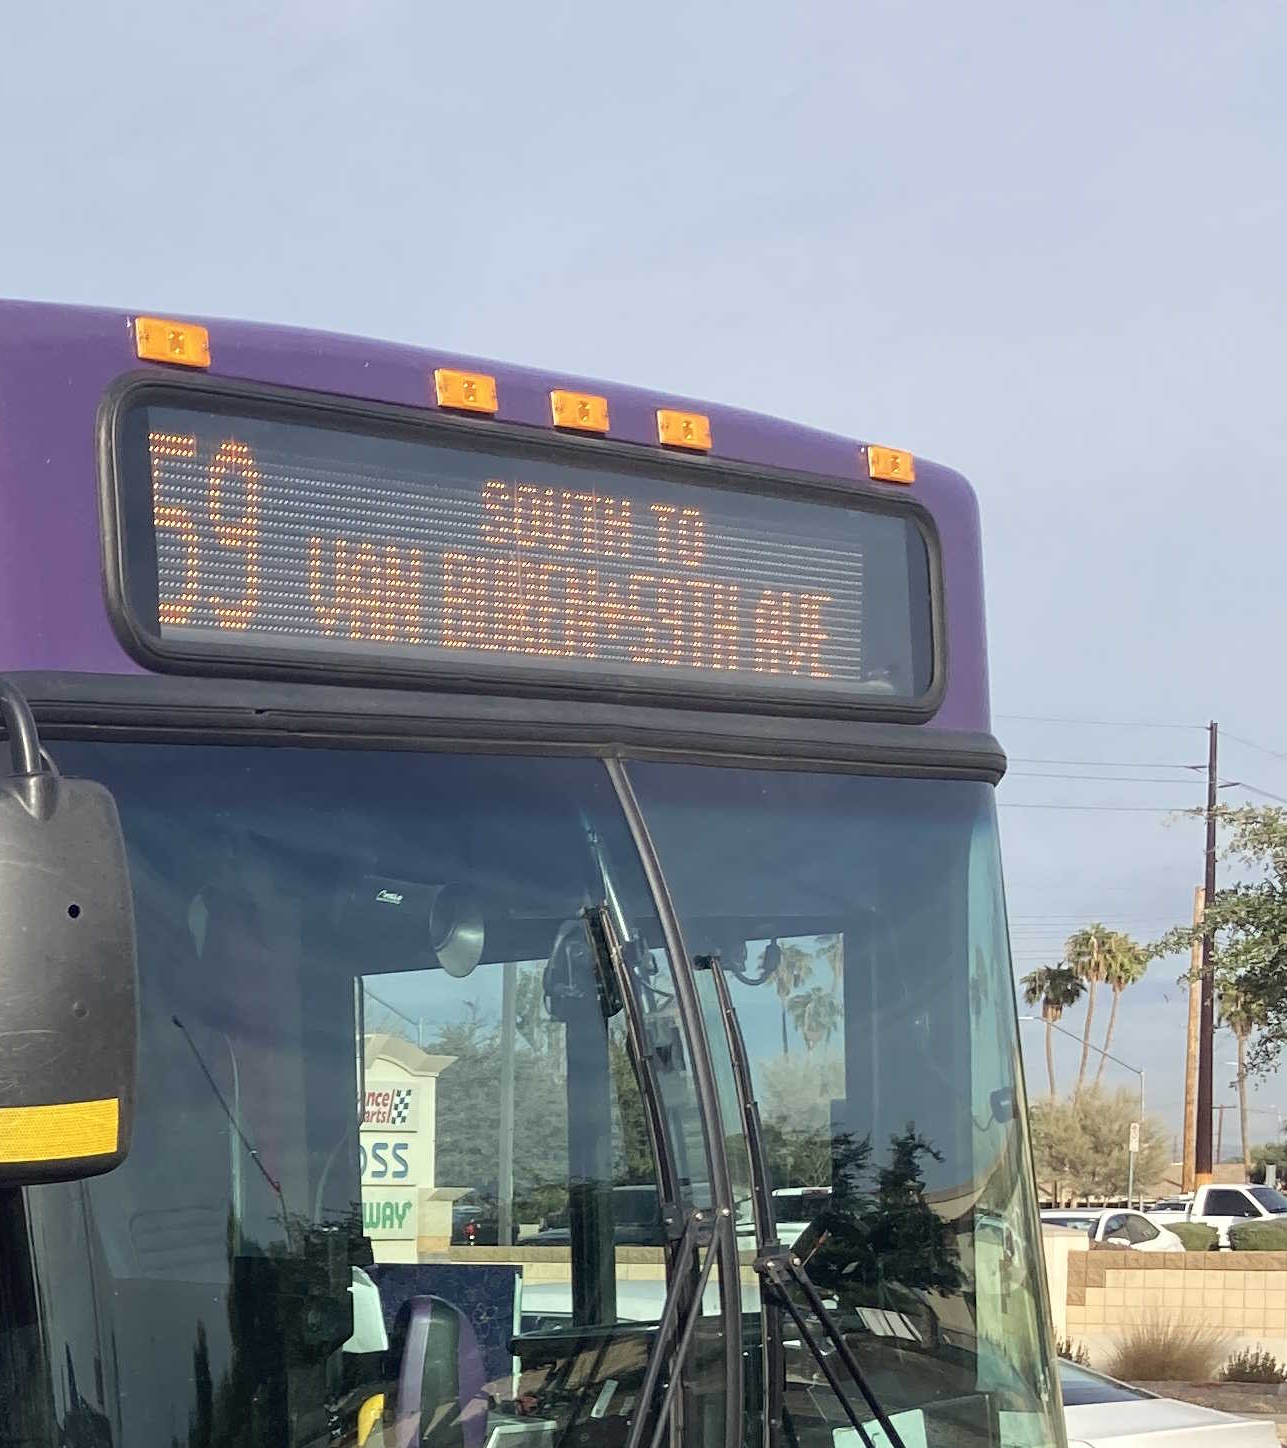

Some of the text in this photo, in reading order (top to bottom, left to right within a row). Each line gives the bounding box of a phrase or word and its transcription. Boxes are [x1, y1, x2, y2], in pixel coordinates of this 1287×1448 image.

[148, 431, 259, 632] 59
[480, 480, 705, 567] SOUTH TO
[309, 535, 422, 645] VAN
